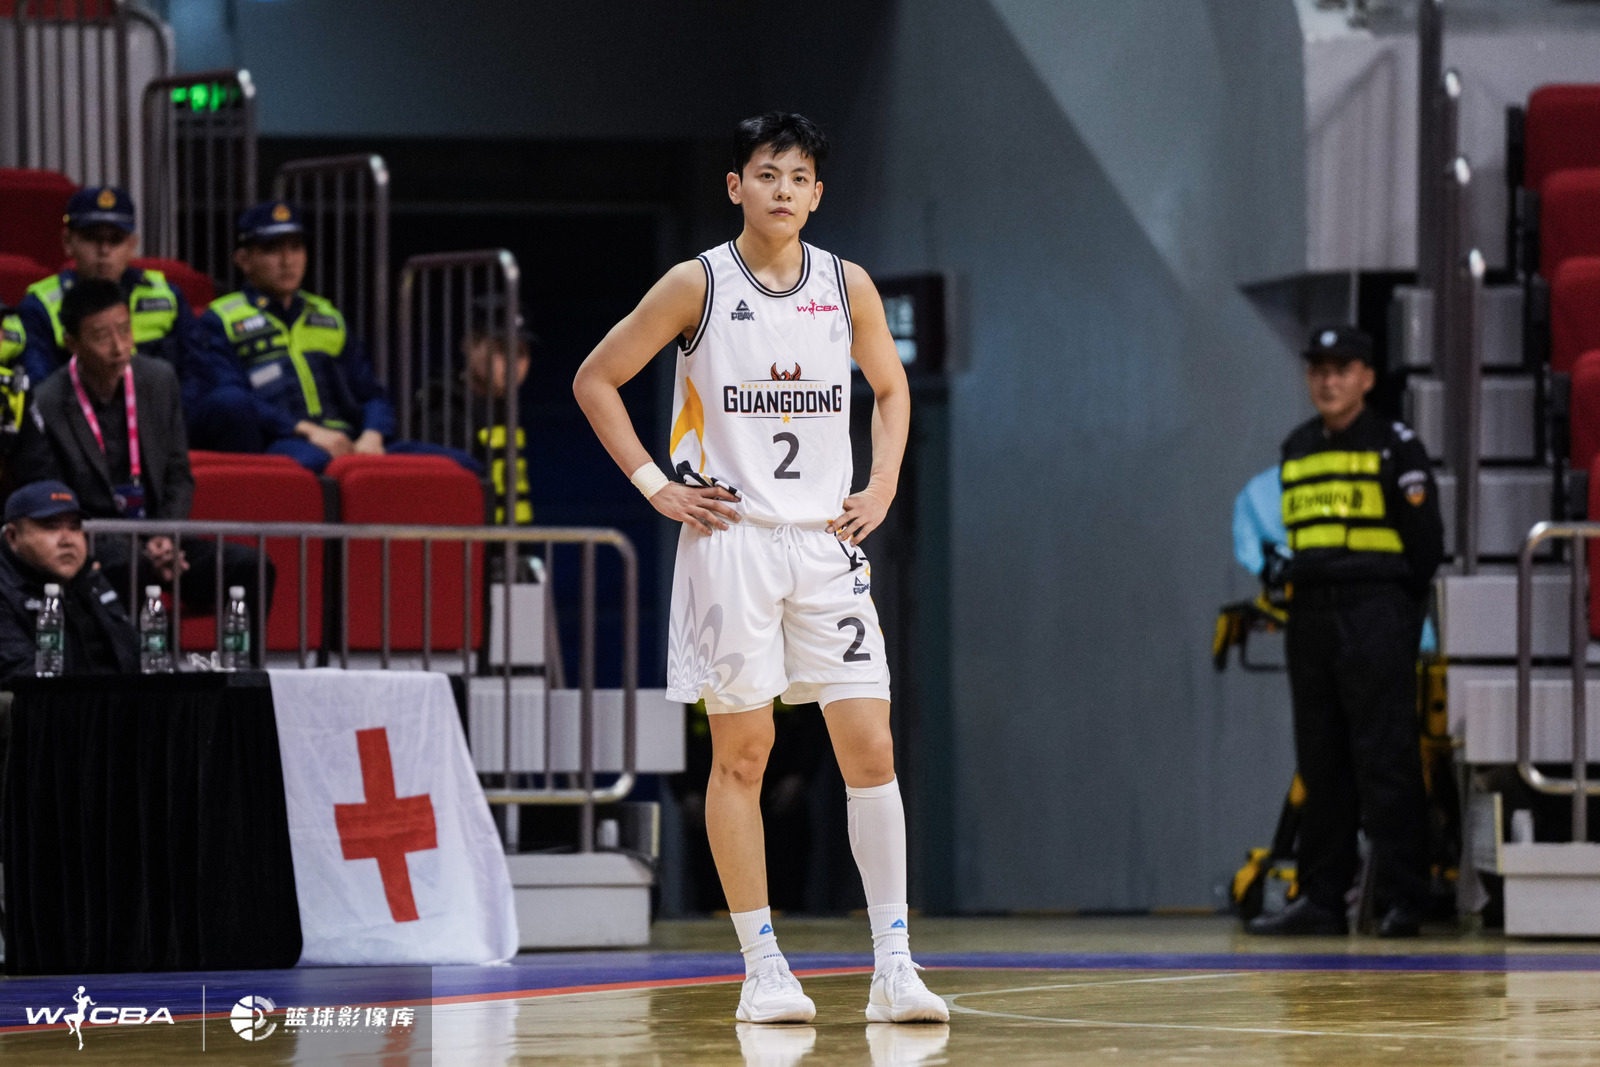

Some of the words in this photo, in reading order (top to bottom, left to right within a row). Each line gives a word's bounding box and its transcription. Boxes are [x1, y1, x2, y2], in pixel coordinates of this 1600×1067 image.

[731, 312, 754, 321] PEAK
[723, 385, 842, 413] GUANGDONG
[773, 432, 800, 479] 2
[837, 617, 871, 663] 2
